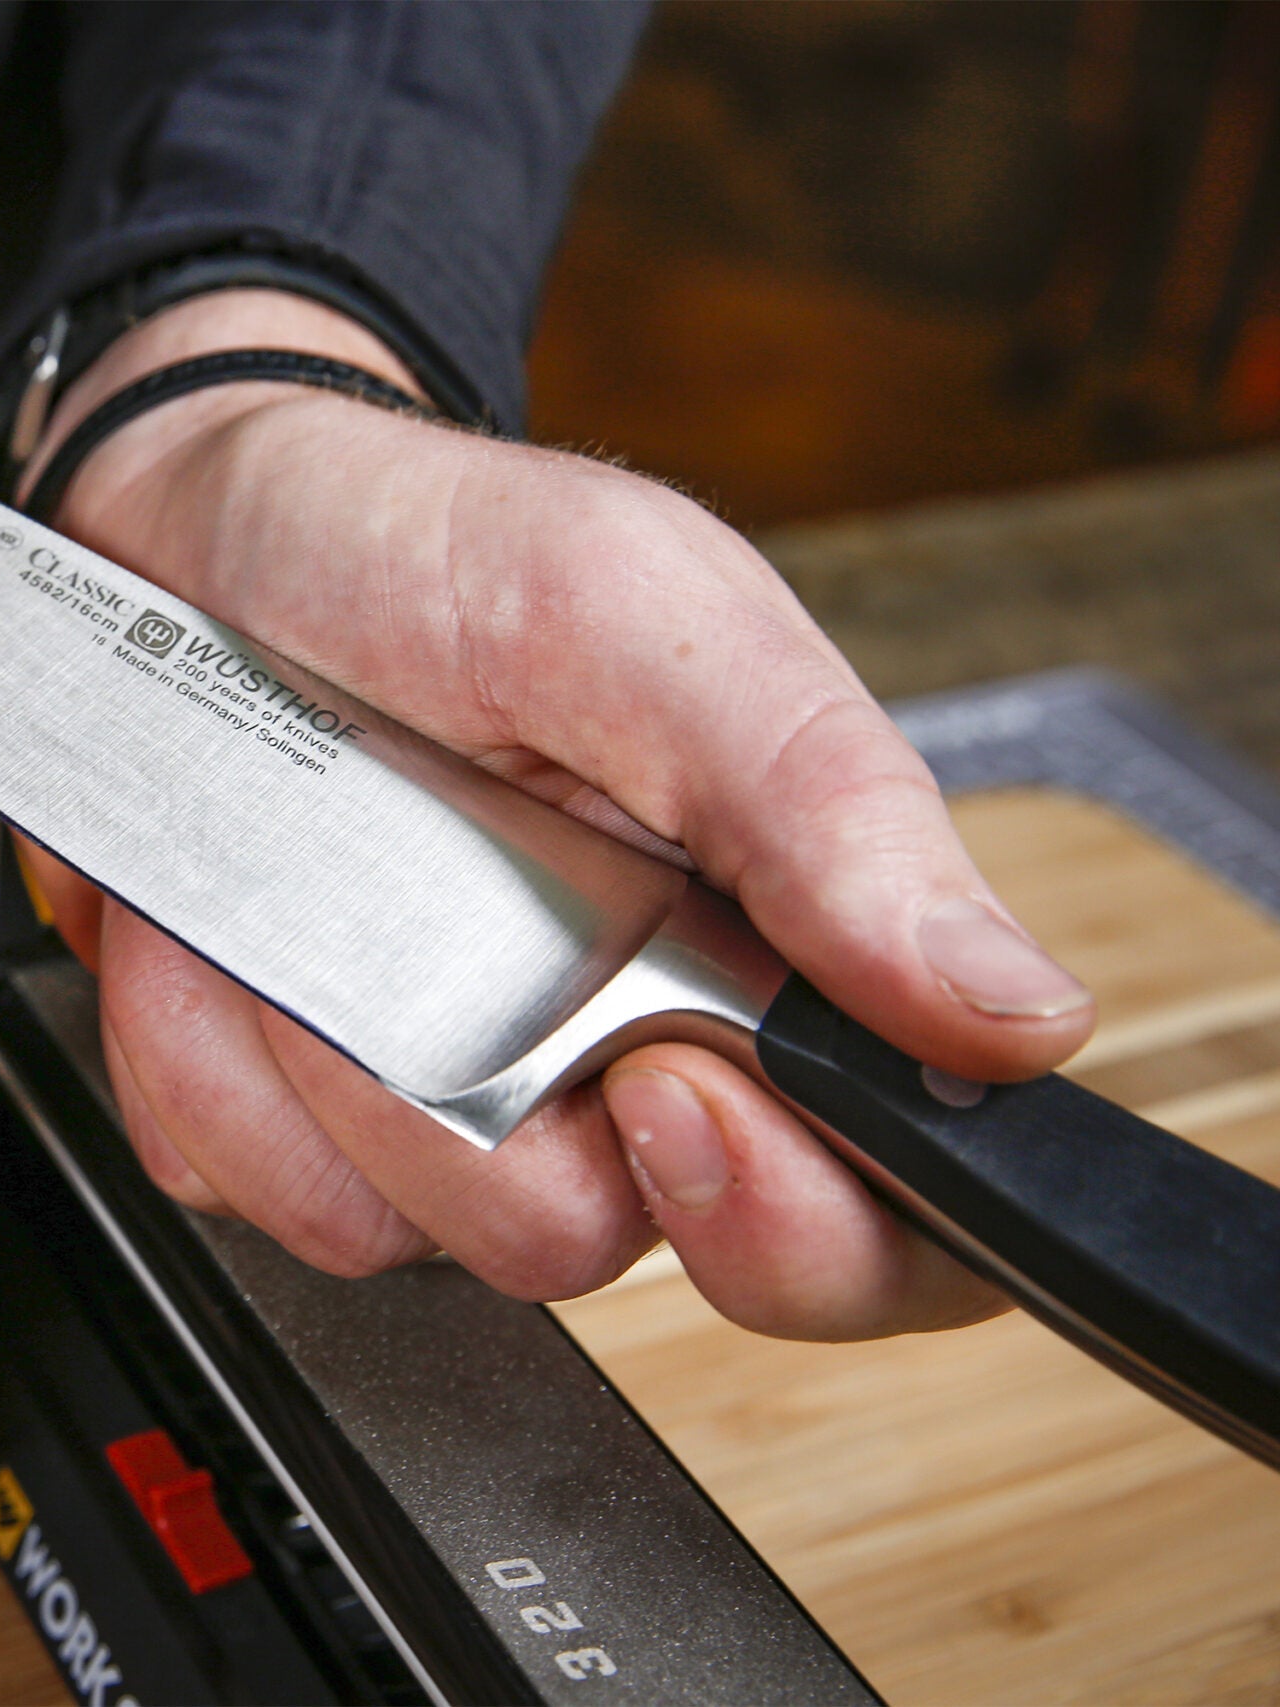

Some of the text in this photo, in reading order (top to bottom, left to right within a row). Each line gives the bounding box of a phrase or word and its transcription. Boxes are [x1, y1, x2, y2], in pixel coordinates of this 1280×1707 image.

[18, 569, 119, 632] 4582/16cm
[28, 547, 136, 617] CLASSIC
[112, 645, 157, 676] Made
[158, 671, 174, 687] in
[173, 658, 339, 759] 200 years of knives
[184, 635, 368, 742] WÜSTHOF
[15, 1522, 123, 1707] WORK
[484, 1557, 618, 1681] 320
